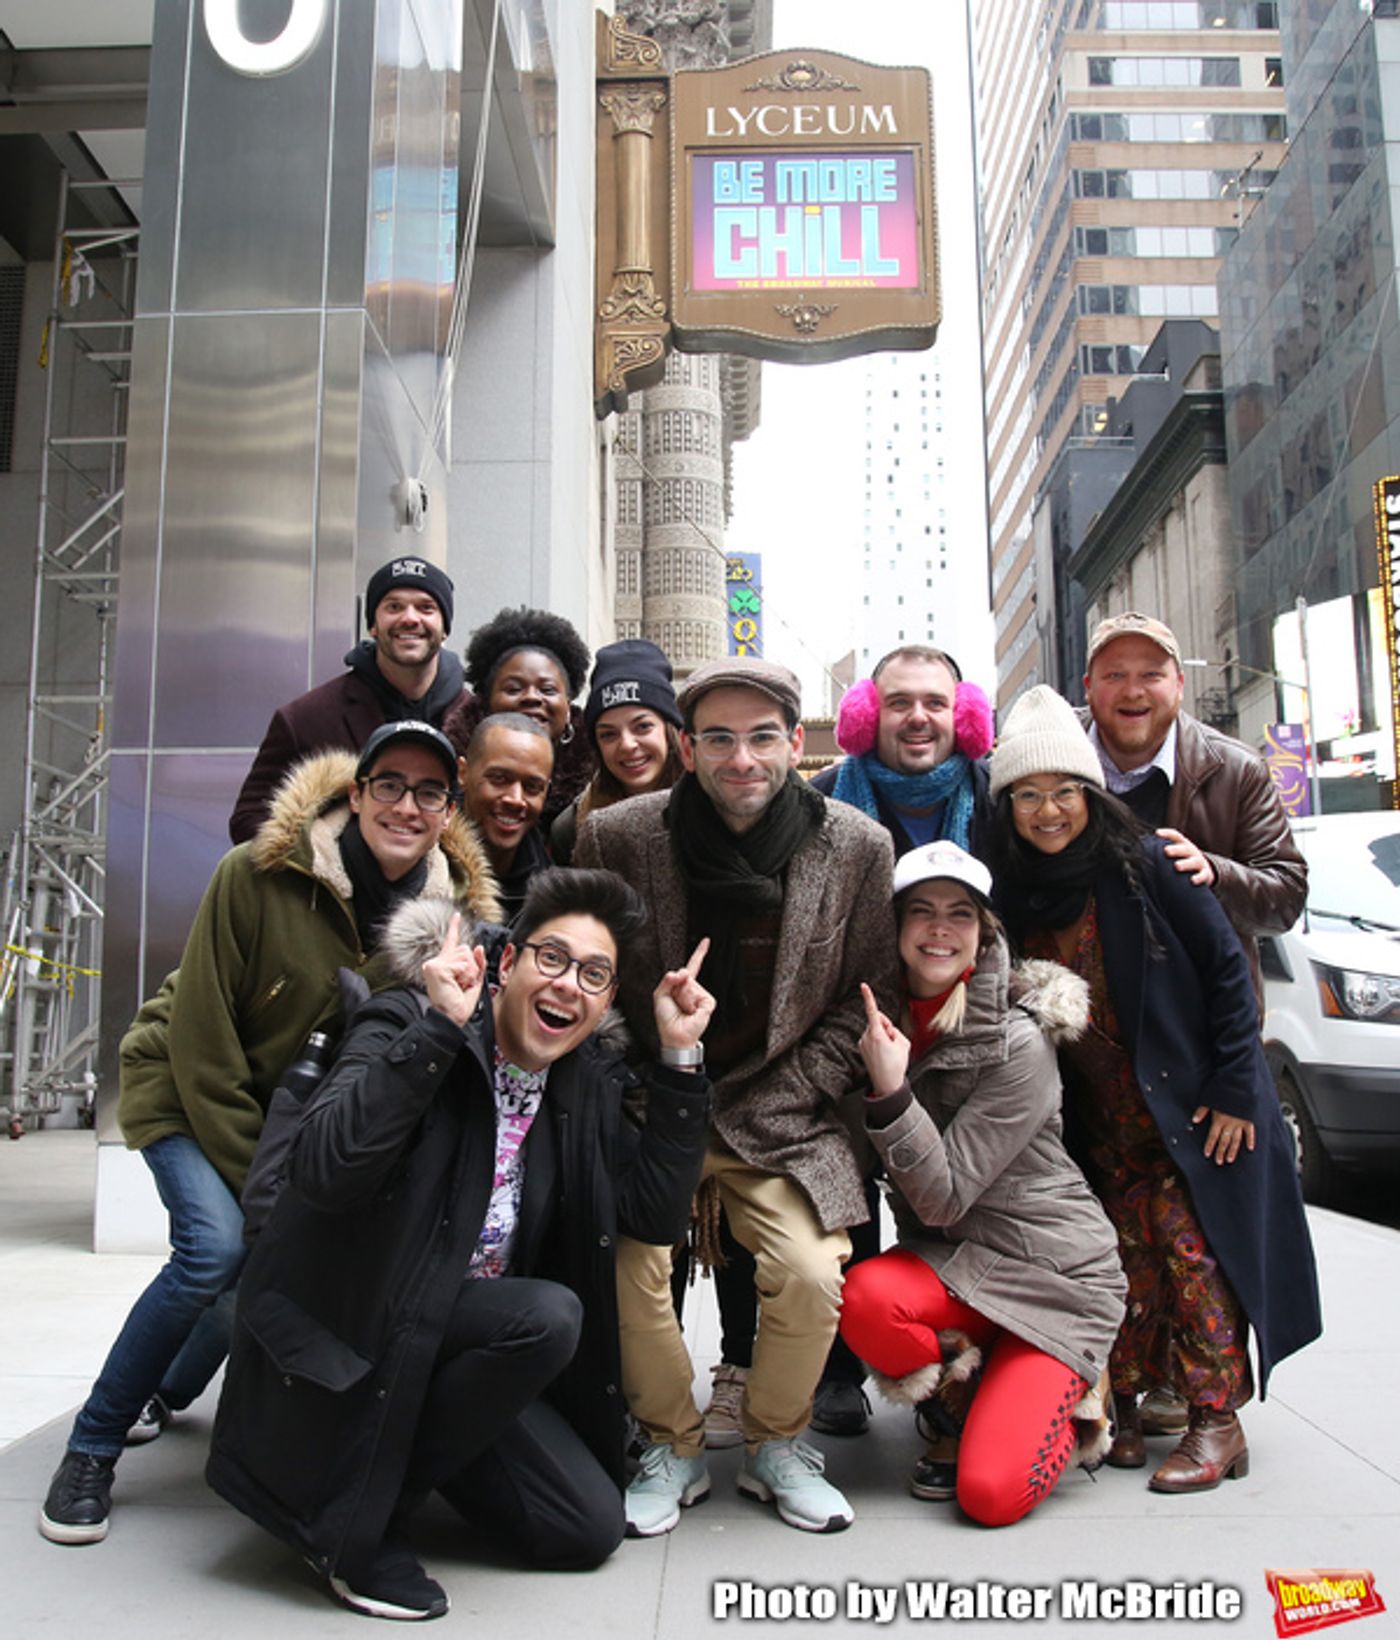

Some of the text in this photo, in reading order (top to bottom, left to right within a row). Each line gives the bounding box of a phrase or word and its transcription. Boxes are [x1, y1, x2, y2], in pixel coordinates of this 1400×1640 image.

[706, 104, 898, 137] LYCEUM
[713, 158, 897, 204] BE MORE
